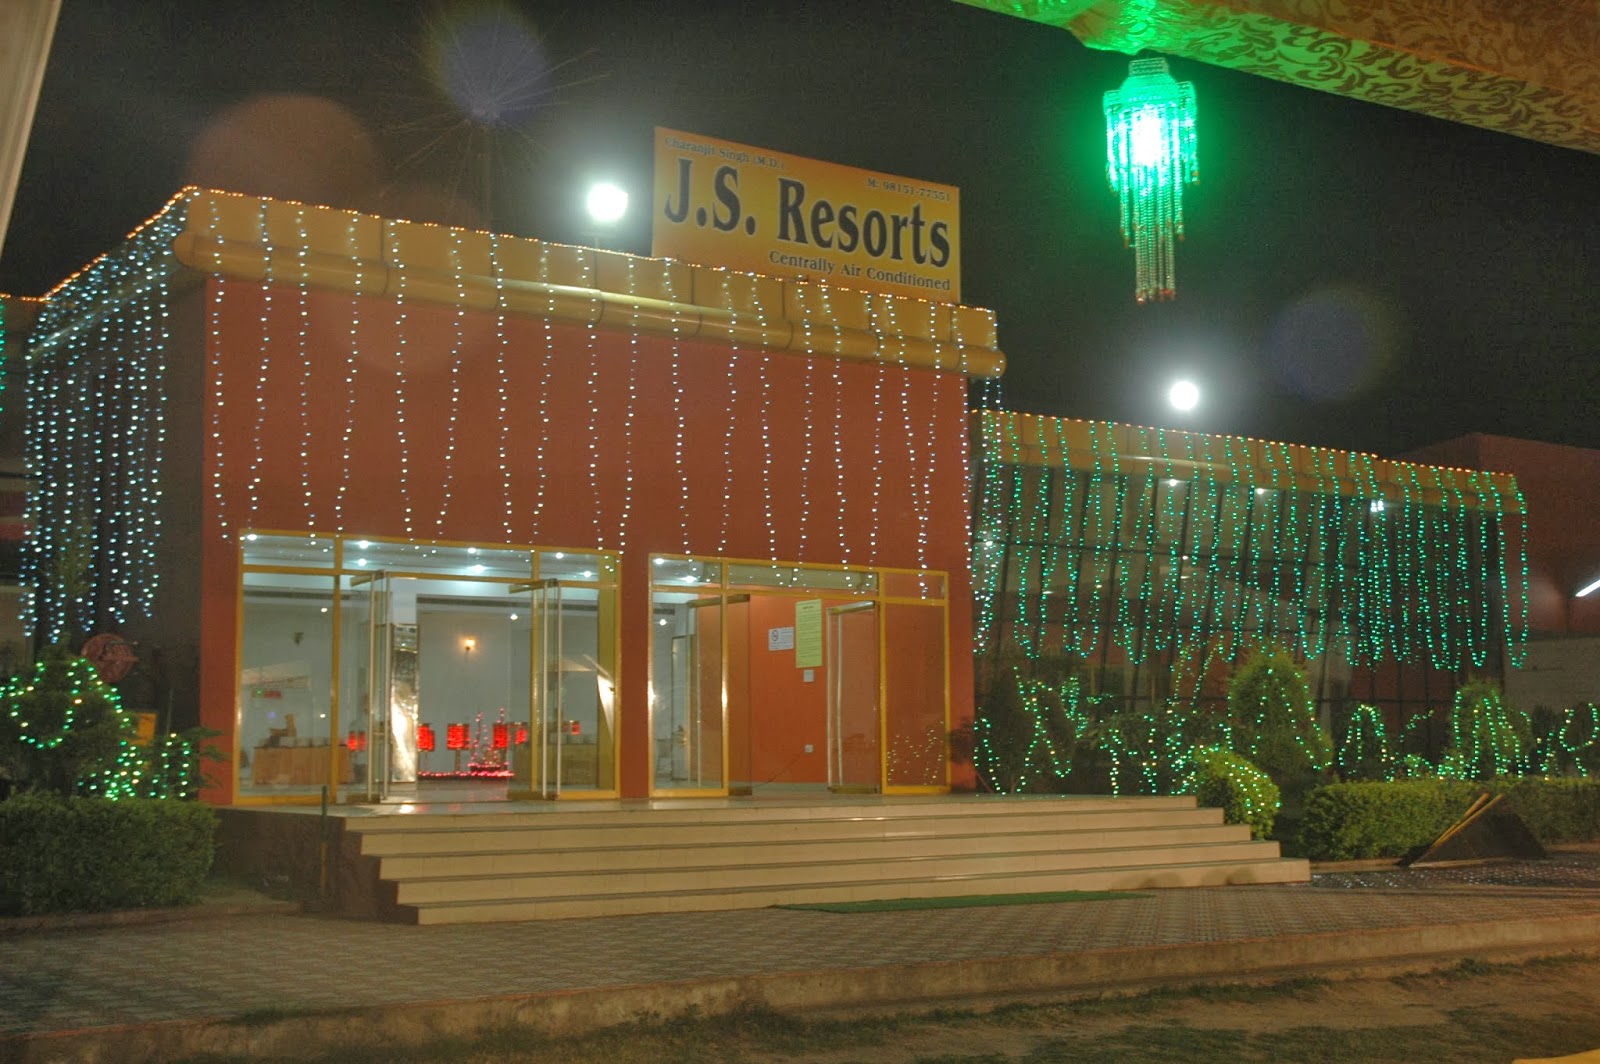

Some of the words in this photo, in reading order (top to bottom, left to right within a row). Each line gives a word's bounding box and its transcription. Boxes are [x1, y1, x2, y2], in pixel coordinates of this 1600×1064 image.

[719, 150, 749, 163] Singh
[664, 158, 756, 236] J.S.
[777, 177, 950, 267] Resorts
[769, 250, 835, 274] Centrally
[841, 264, 862, 277] Air
[867, 267, 950, 290] Conditioned
